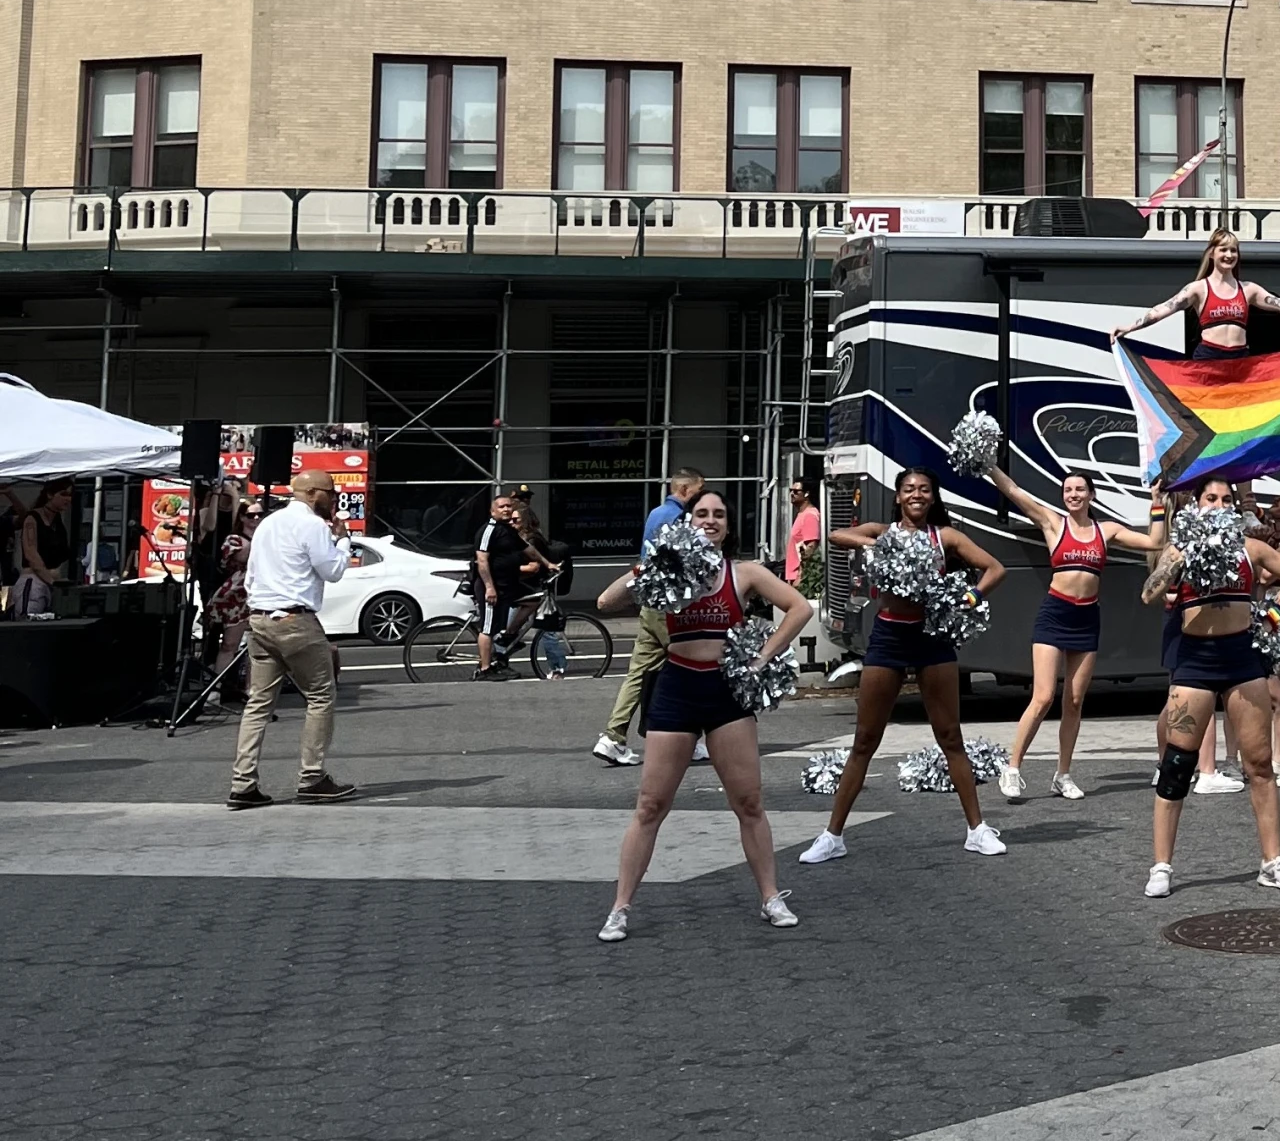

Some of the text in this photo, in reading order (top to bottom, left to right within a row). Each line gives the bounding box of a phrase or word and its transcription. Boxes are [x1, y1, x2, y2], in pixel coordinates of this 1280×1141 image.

[850, 212, 890, 233] WE
[567, 459, 645, 470] RETAIL SPAC
[582, 538, 634, 548] NEWMARK
[170, 550, 186, 561] DO
[675, 613, 730, 626] NEW YORK
